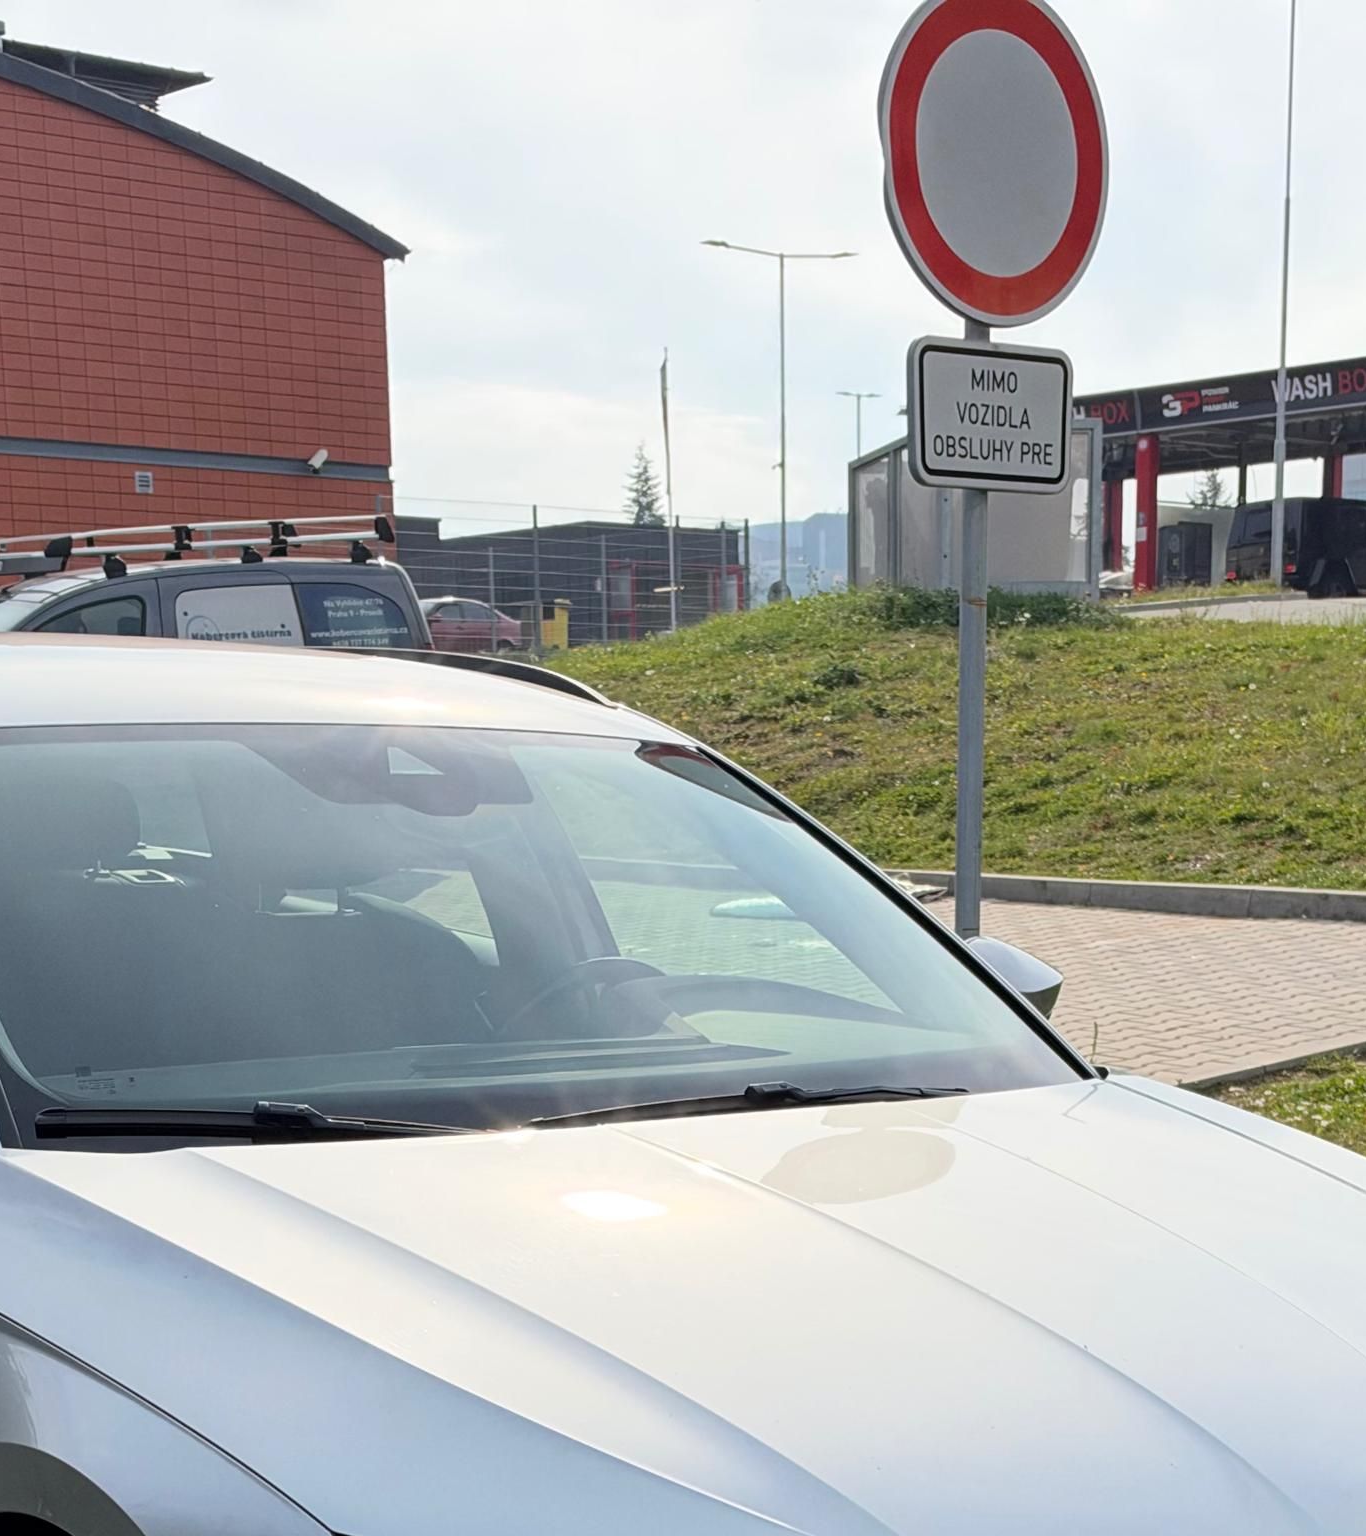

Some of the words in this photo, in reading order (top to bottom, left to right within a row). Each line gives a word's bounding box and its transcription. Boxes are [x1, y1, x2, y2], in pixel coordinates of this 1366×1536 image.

[971, 368, 1018, 394] MIMO
[1271, 372, 1332, 402] WASH
[956, 401, 1031, 429] VOZIDLA
[933, 434, 1014, 462] OBSLUHY
[1020, 442, 1054, 466] PRE
